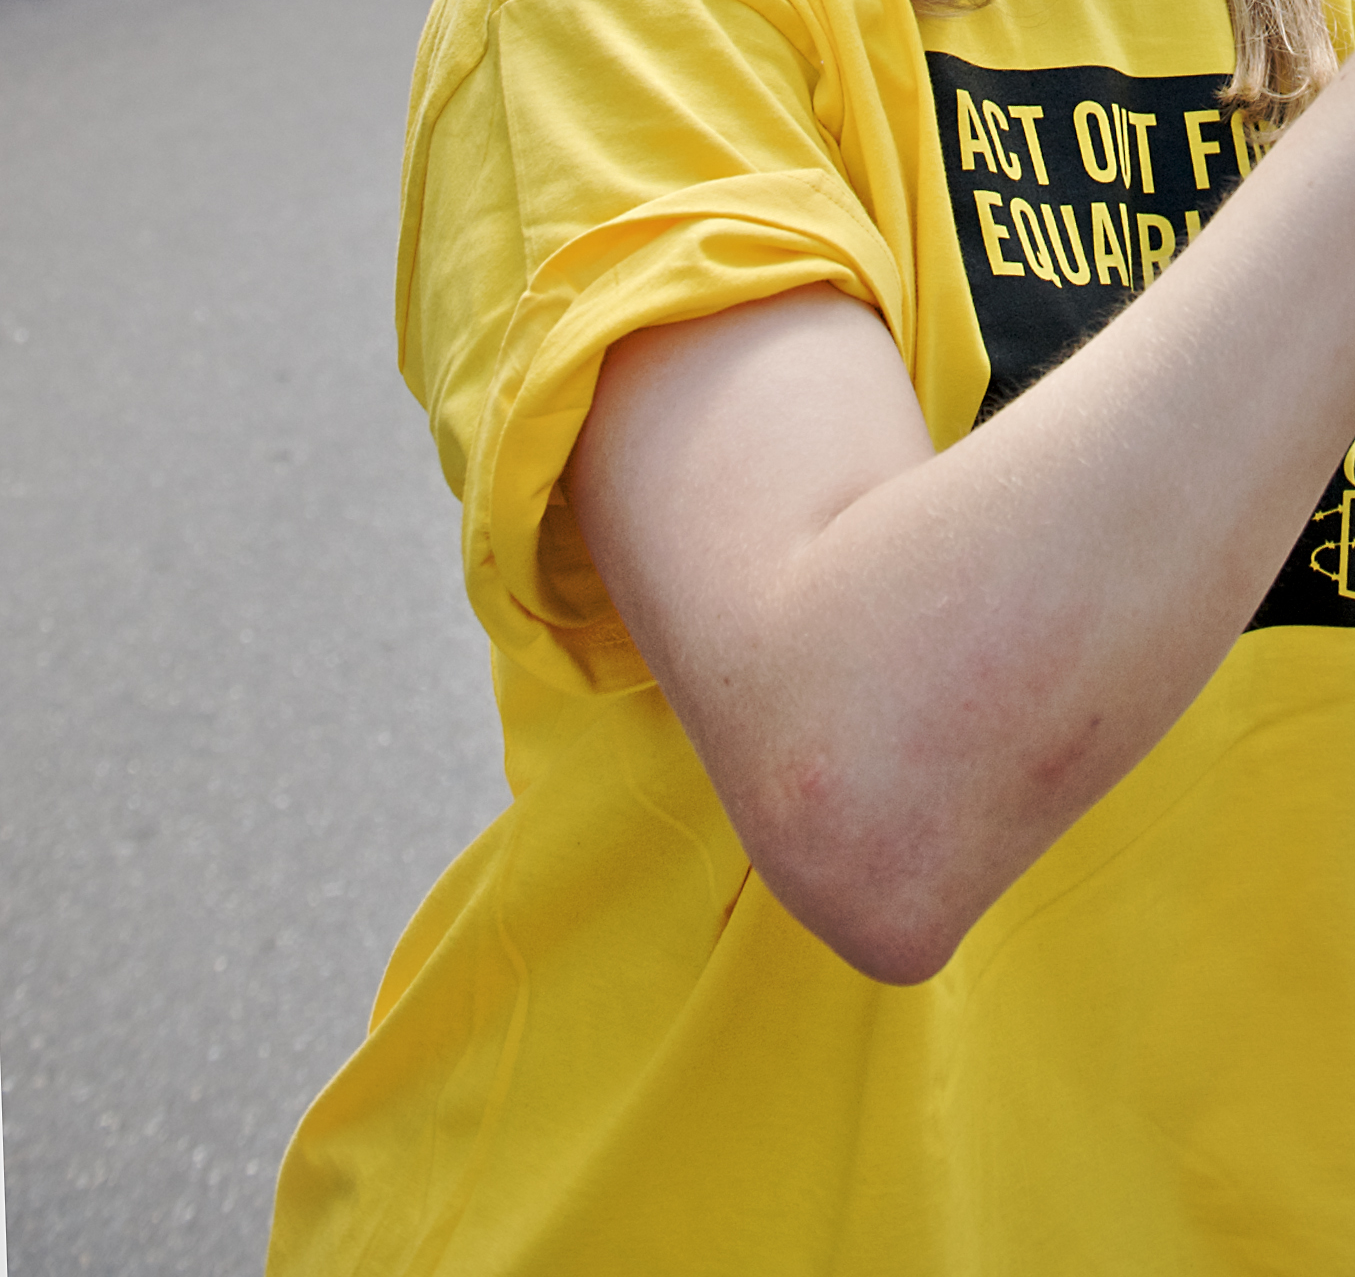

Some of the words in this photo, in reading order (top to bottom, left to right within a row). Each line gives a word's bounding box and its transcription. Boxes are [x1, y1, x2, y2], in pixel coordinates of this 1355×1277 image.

[957, 88, 1050, 185] ACT
[1073, 100, 1157, 194] OUT
[1183, 109, 1283, 190] FO
